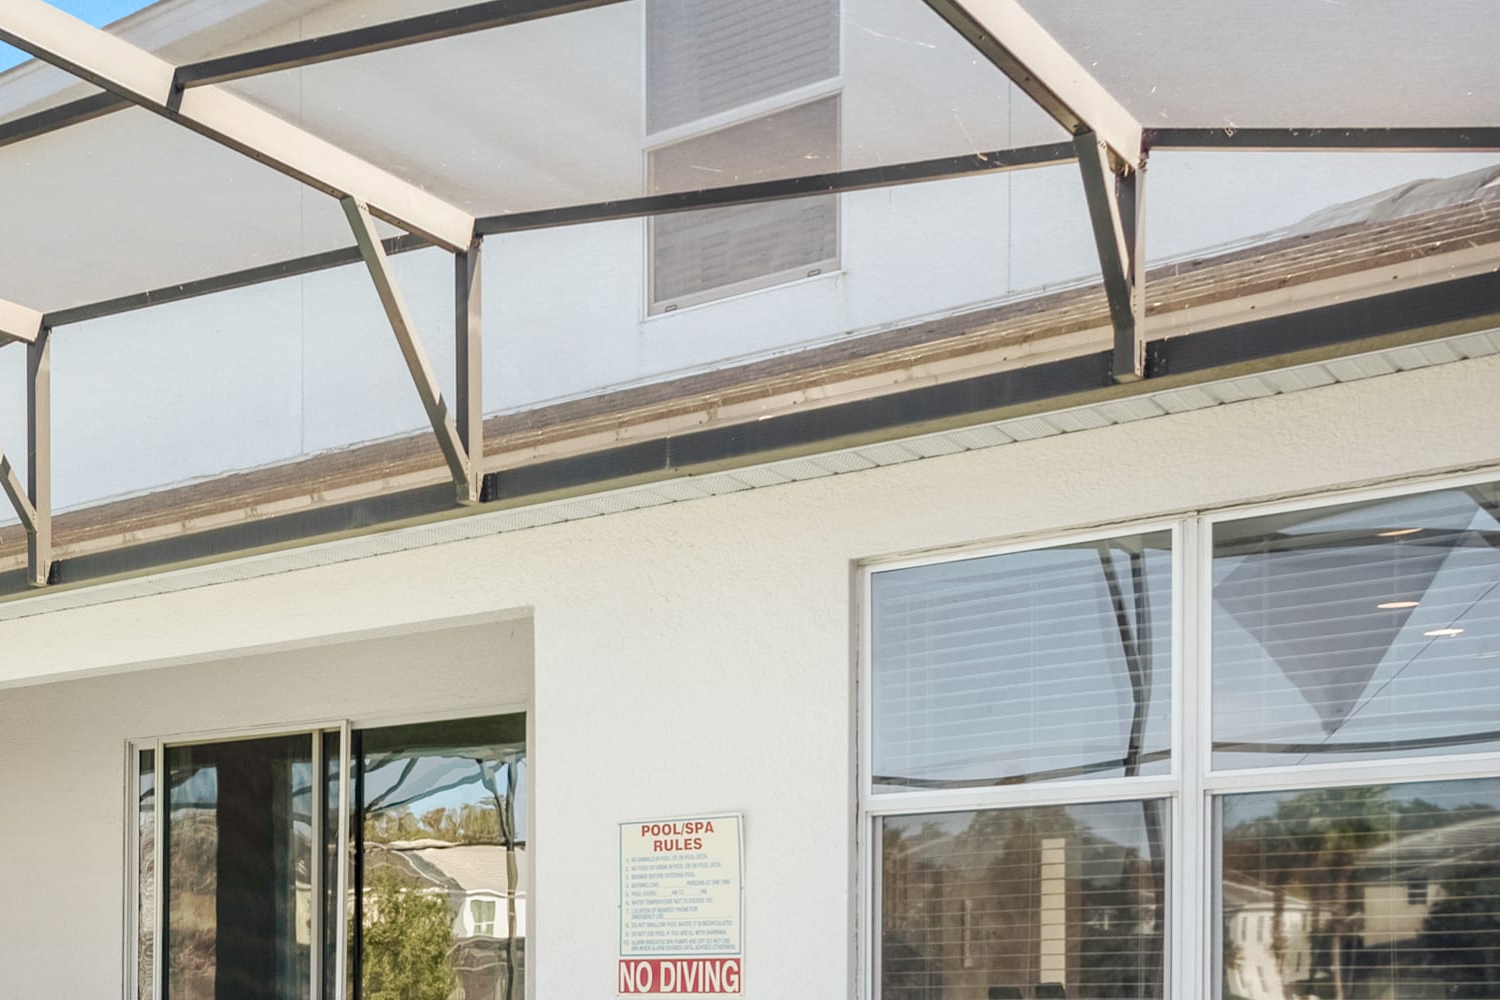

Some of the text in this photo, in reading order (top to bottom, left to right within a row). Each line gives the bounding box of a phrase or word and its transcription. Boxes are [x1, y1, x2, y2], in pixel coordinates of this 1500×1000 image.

[641, 821, 714, 837] POOL/SPA
[653, 837, 703, 852] RULES
[619, 959, 740, 993] NO DIVING
